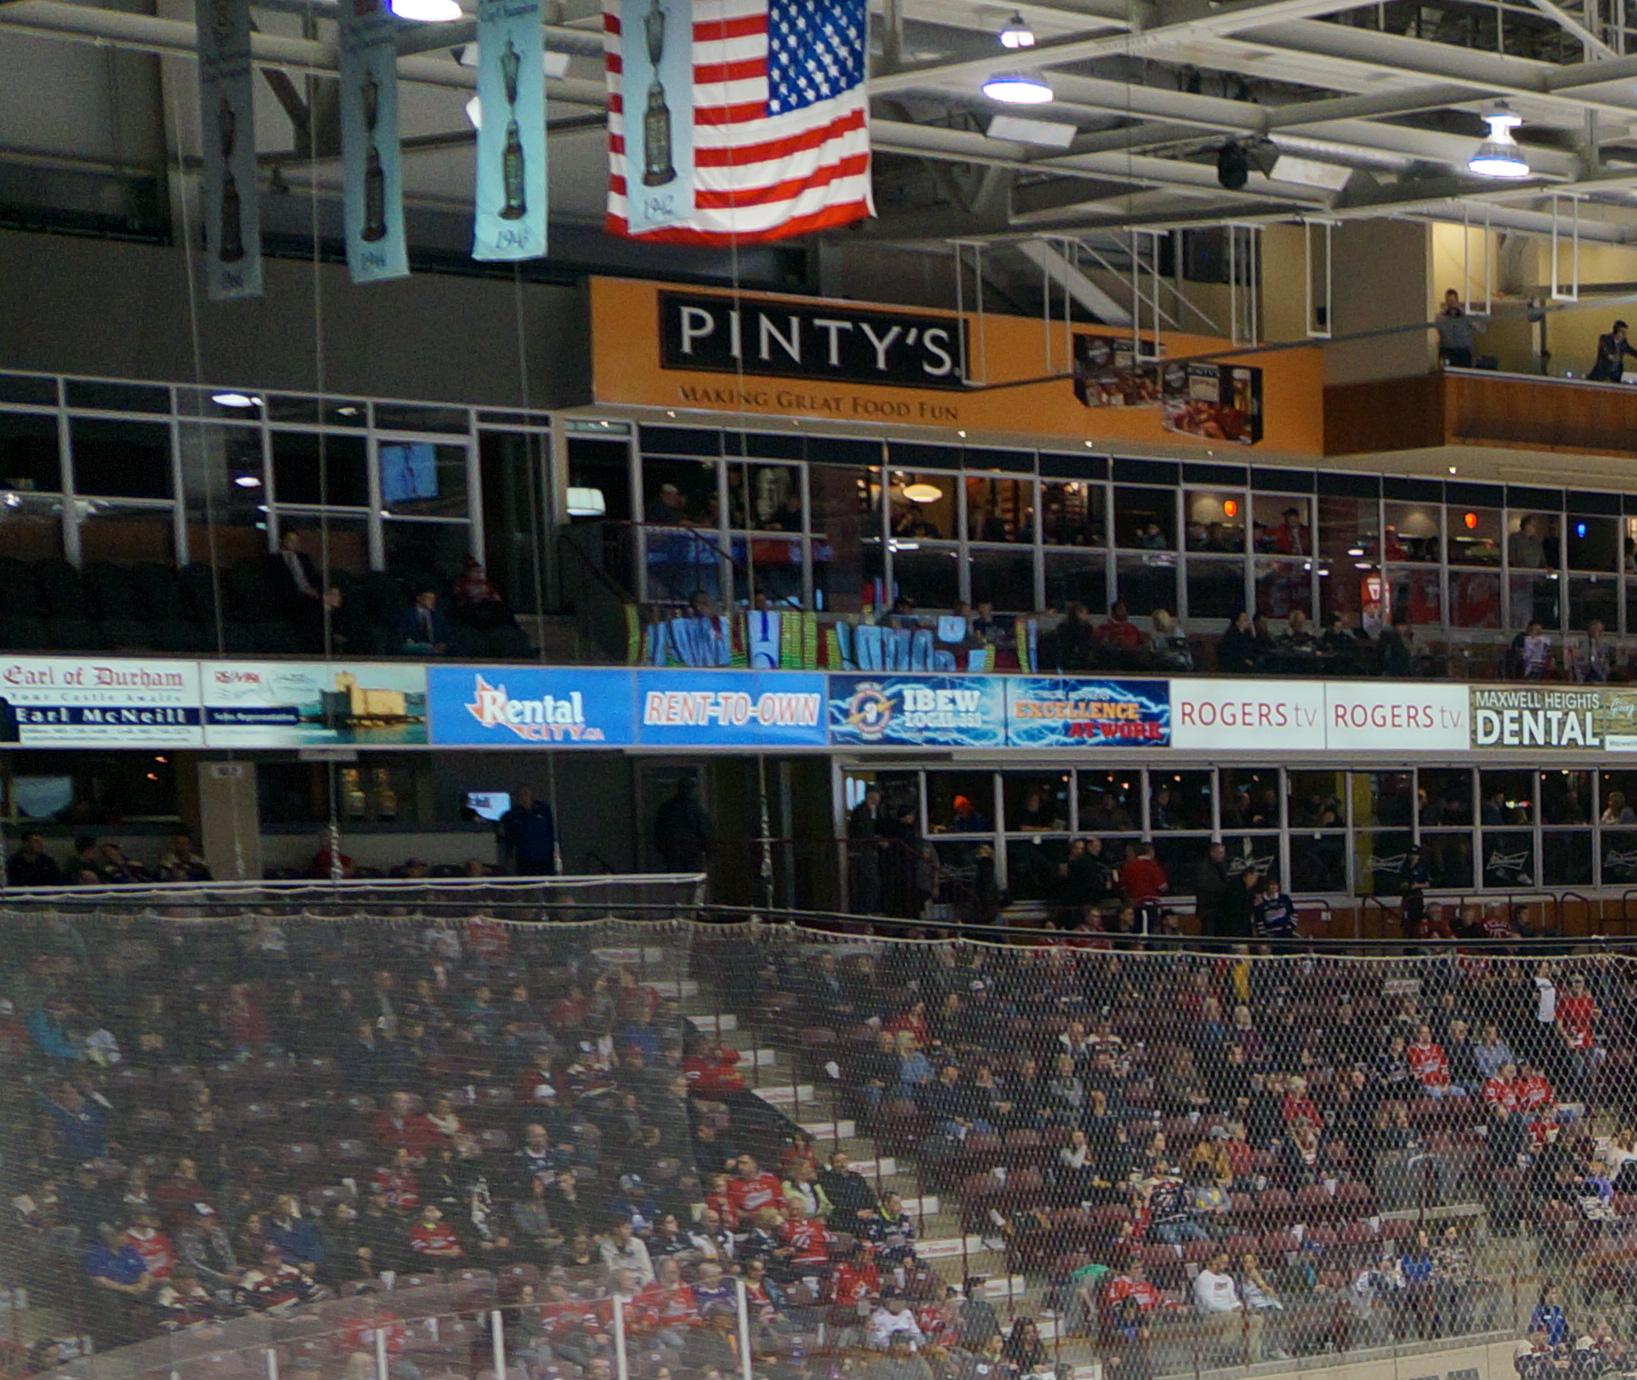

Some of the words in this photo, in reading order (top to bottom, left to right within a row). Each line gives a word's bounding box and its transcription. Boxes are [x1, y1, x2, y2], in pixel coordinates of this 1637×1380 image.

[680, 305, 955, 375] PINTY'S
[679, 385, 767, 411] MAKING
[776, 390, 843, 415] GREAT
[852, 394, 911, 418] FOOD
[918, 400, 959, 421] FUN
[64, 667, 83, 686] of
[92, 666, 184, 688] Durham
[481, 689, 585, 727] Rental
[644, 691, 821, 727] RENT-TO-OWN
[903, 688, 982, 712] IBEW
[1013, 701, 1141, 720] EXCELLENCE
[1475, 691, 1540, 709] MAXWELL
[1545, 692, 1600, 710] HEIGHTS
[15, 707, 69, 723] Earl
[82, 707, 188, 724] McNeill
[1180, 701, 1287, 727] ROGERS
[1294, 704, 1318, 728] tv
[1334, 703, 1434, 728] ROGERS
[1440, 706, 1463, 729] tv
[1068, 721, 1093, 738] AT
[1100, 722, 1163, 739] WORK
[1476, 710, 1600, 747] DENTAL
